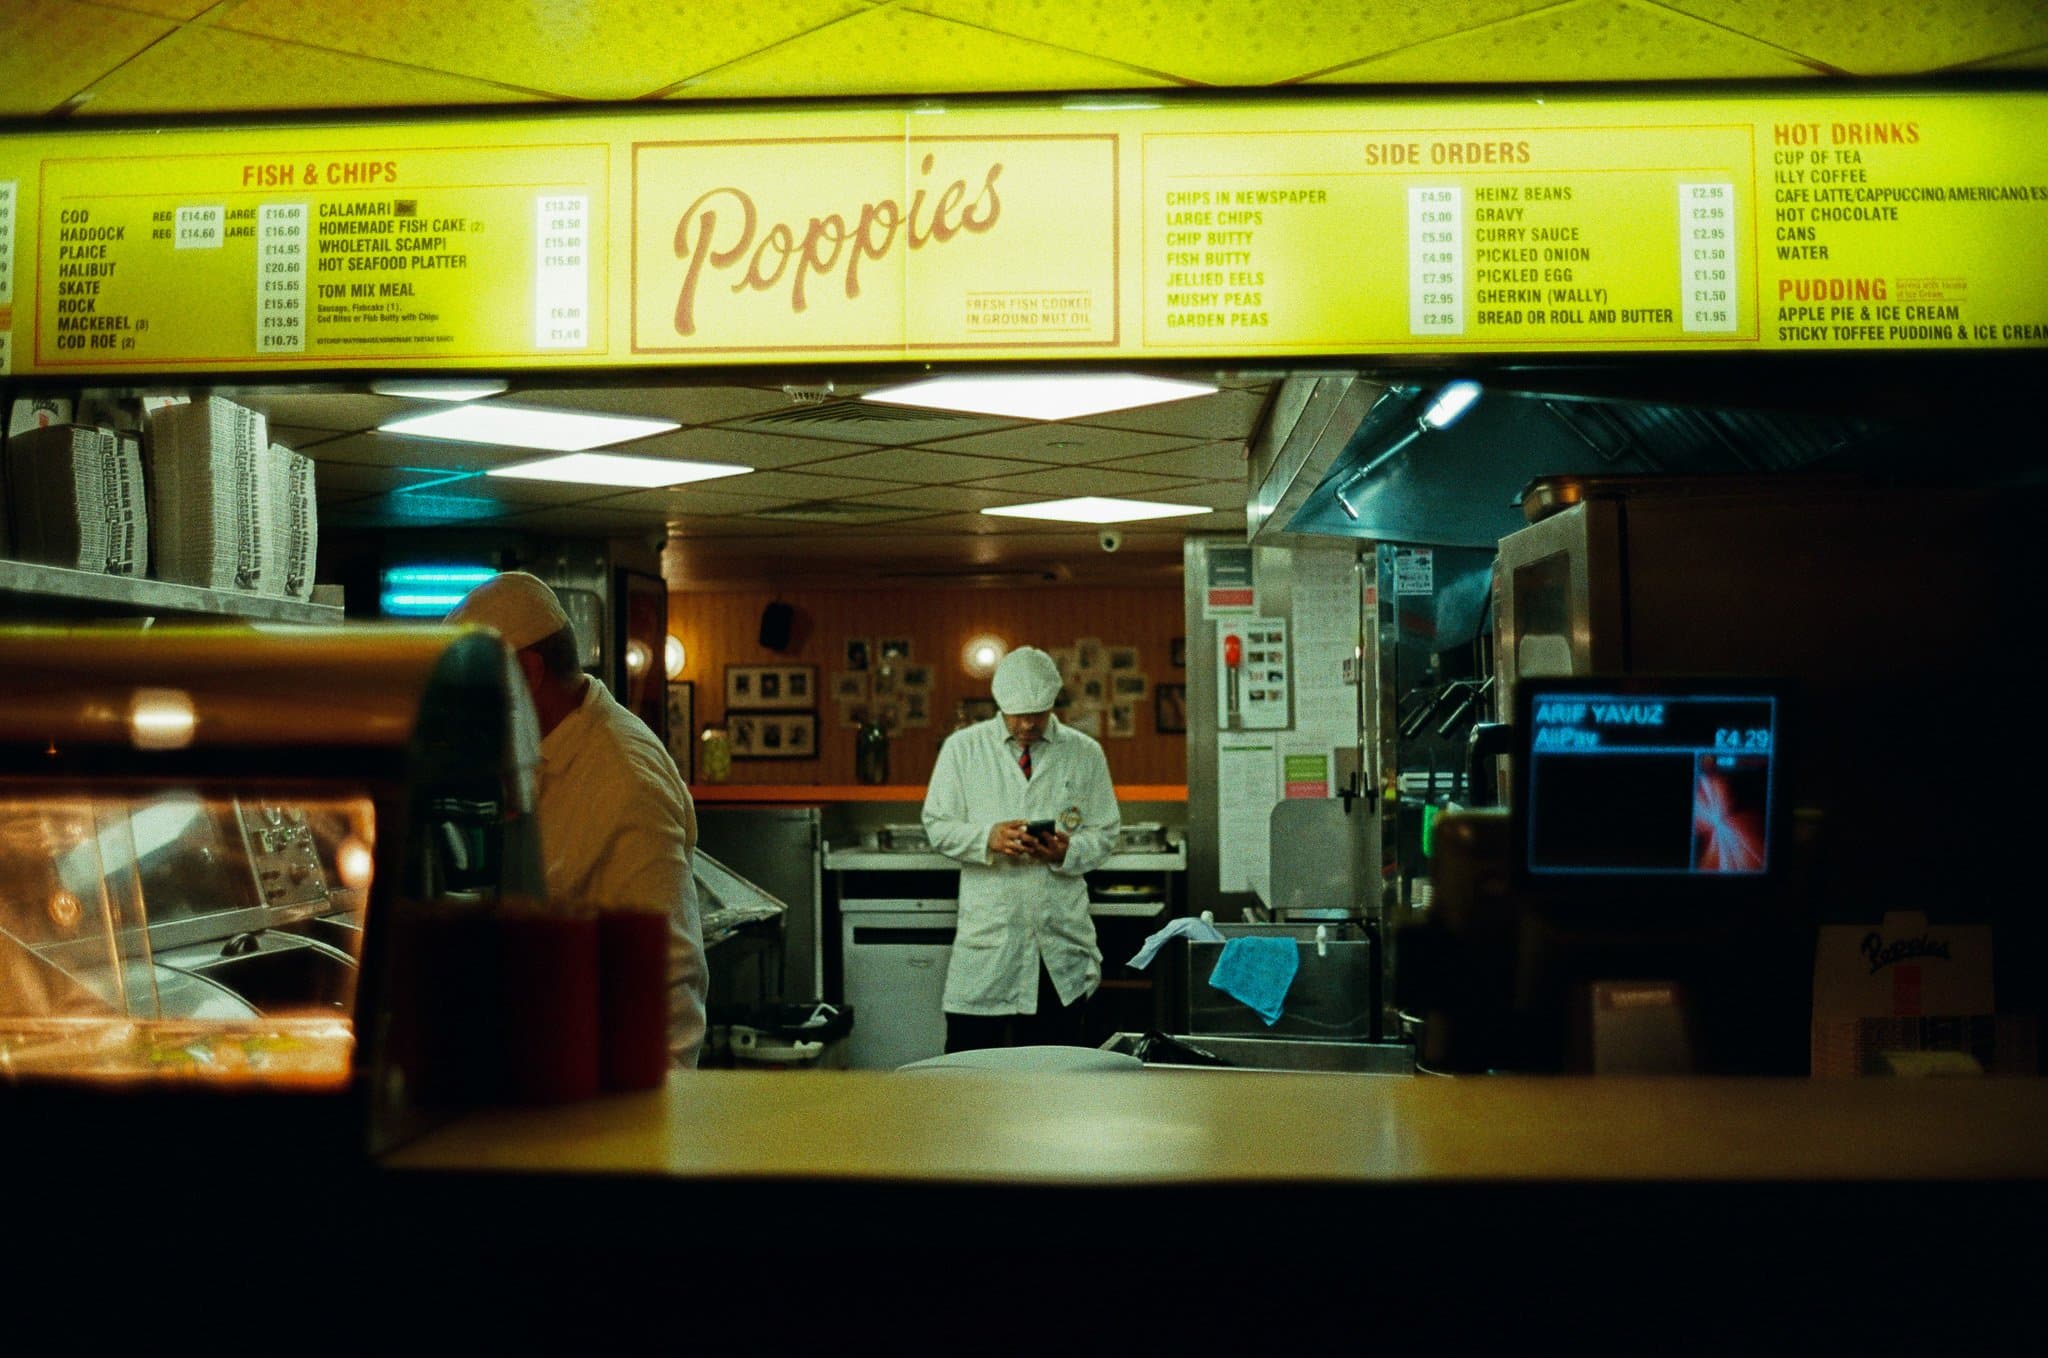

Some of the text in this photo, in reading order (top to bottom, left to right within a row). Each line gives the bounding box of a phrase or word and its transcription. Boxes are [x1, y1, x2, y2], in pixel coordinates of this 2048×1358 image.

[1774, 122, 1920, 145] HOT DRINKS
[1365, 142, 1529, 165] SIDE ORDERS
[1775, 150, 1861, 164] CUP OF TEA
[243, 161, 397, 186] FISH & CHIPS
[1775, 169, 1867, 183] ILLY COFFEE
[1166, 190, 1327, 206] CHIPS IN NEWSPAPER
[1476, 187, 1572, 201] HEINZ BEANS
[1776, 189, 1809, 203] CAFE
[61, 210, 89, 224] COD
[153, 212, 172, 222] REG
[225, 209, 256, 220] LARGE
[320, 203, 391, 217] CALAMARI
[1476, 208, 1524, 221] GRAVY
[1776, 207, 1898, 221] HOT CHOCOLATE
[1167, 212, 1263, 225] LARGE CHIPS
[60, 227, 125, 241] HADDOCK
[153, 229, 171, 239] REG
[224, 226, 256, 237] LARGE
[319, 220, 395, 235] HOMEMADE
[400, 220, 428, 233] FISH
[433, 219, 466, 233] CAKE
[1167, 232, 1253, 246] CHIP BUTTY
[1476, 228, 1579, 242] CURRY SAUCE
[1777, 228, 1816, 241] CANS
[319, 238, 446, 254] WHOLETAIL SCAMPI
[674, 152, 1003, 337] Poppies
[60, 246, 106, 259] PLAICE
[1167, 252, 1251, 266] FISH BUTTY
[1477, 248, 1590, 262] PICKLED ONION
[1777, 247, 1829, 260] WATER
[59, 263, 116, 277] HALIBUT
[319, 255, 467, 272] HOT SEAFOOD PLATTER
[1167, 273, 1264, 286] JELLIED EELS
[1477, 269, 1573, 283] PICKLED EGG
[59, 281, 100, 295] SKATE
[318, 283, 415, 298] TOM MIX MEAL
[1778, 279, 1886, 301] PUDDING
[1167, 293, 1261, 307] MUSHY PEAS
[1478, 289, 1608, 305] GHERKIN (WALLY)
[58, 299, 96, 314] ROCK
[1010, 299, 1037, 310] FISH
[966, 314, 979, 324] IN
[983, 313, 1038, 324] GROUND
[1042, 313, 1066, 323] NUT
[1168, 313, 1268, 327] GARDEN PEAS
[1478, 309, 1673, 324] BREAD OR ROLL AND BUTTER
[1778, 306, 1959, 321] APPLE PIE & ICE CREAM
[58, 317, 130, 332] MACKEREL
[1779, 327, 1828, 341] STICKY
[1832, 327, 1885, 340] TOFFEE
[1890, 326, 1952, 340] PUDDING
[1958, 326, 1968, 339] &
[1974, 325, 1997, 339] ICE
[57, 334, 135, 349] COD ROE (2)
[1591, 704, 1664, 724] YAVUZ
